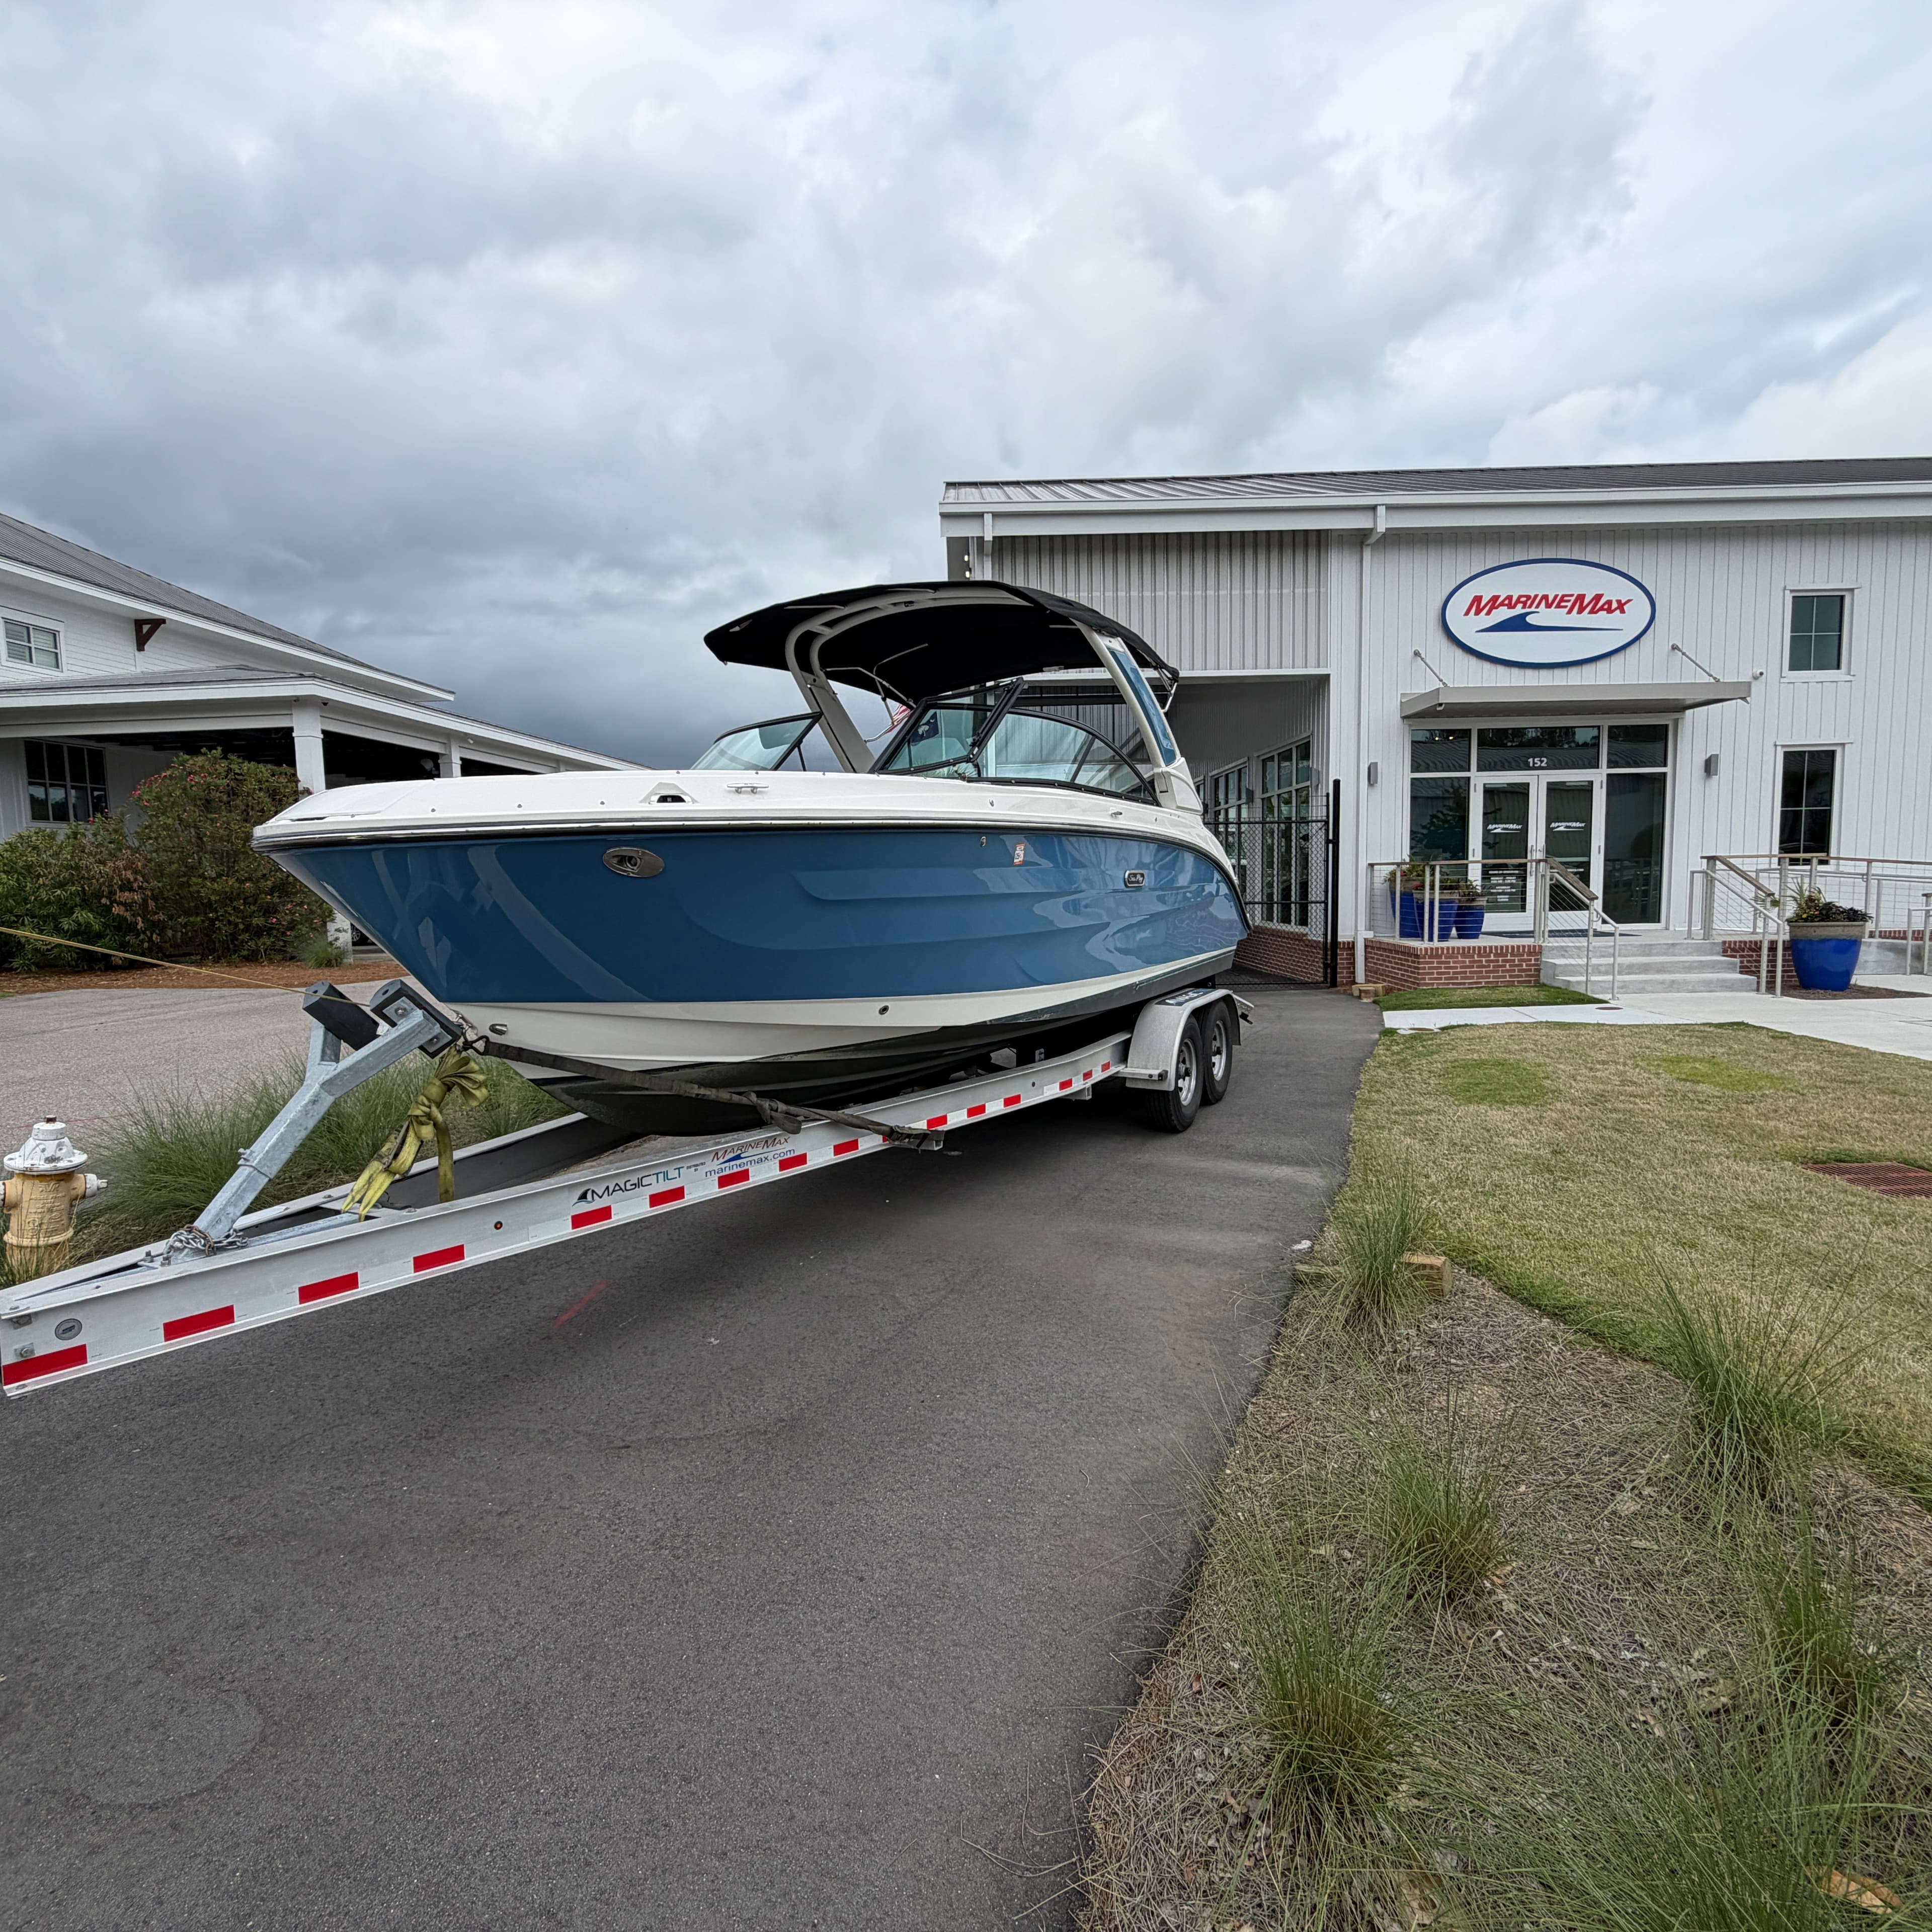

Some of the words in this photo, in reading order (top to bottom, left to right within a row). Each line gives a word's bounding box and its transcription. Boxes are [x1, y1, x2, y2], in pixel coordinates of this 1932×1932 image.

[1527, 757, 1548, 767] 152
[705, 1149, 795, 1178] marinemax.com
[591, 1166, 685, 1201] MAGICTILT
